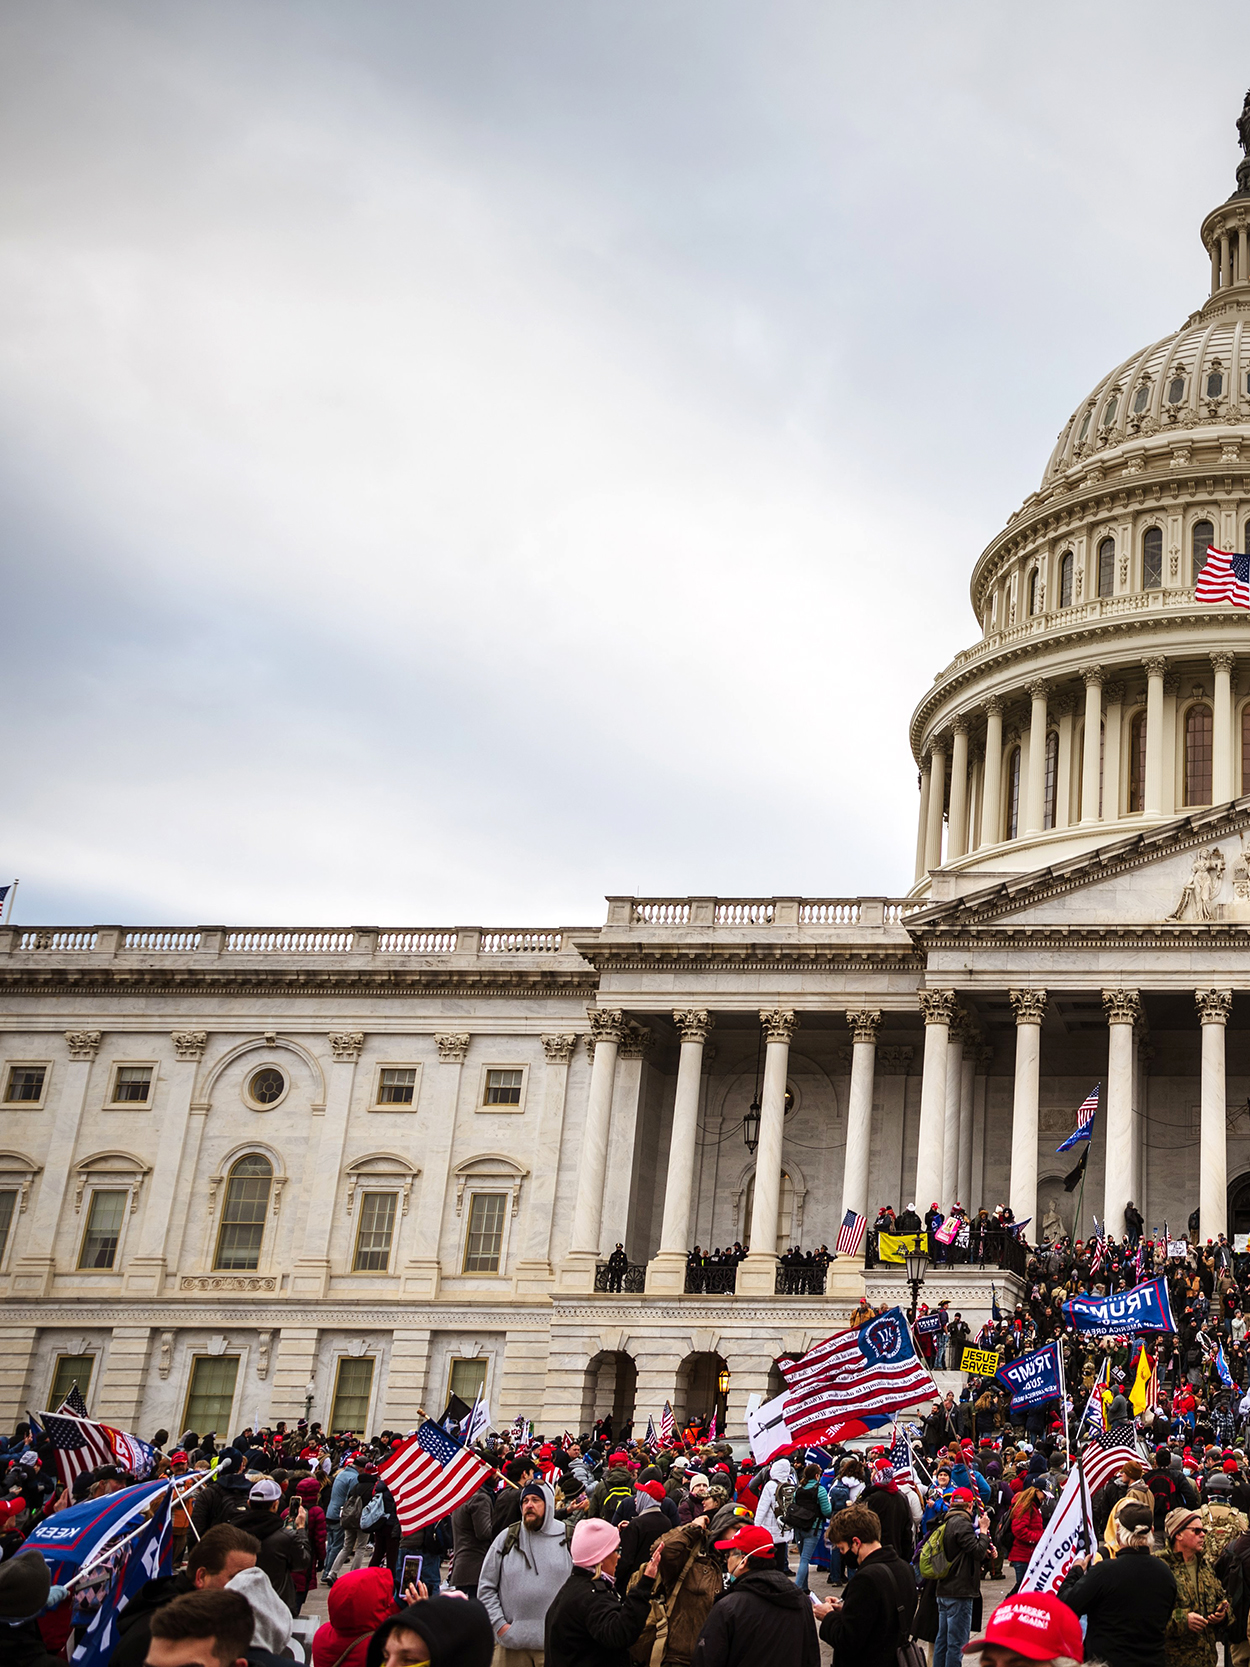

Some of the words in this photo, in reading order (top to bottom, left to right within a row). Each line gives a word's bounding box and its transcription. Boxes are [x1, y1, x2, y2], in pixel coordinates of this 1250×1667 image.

[918, 1318, 938, 1326] TRUMP
[964, 1350, 996, 1364] JESUS
[962, 1360, 995, 1375] SAVES
[1012, 1604, 1051, 1621] AMERICA
